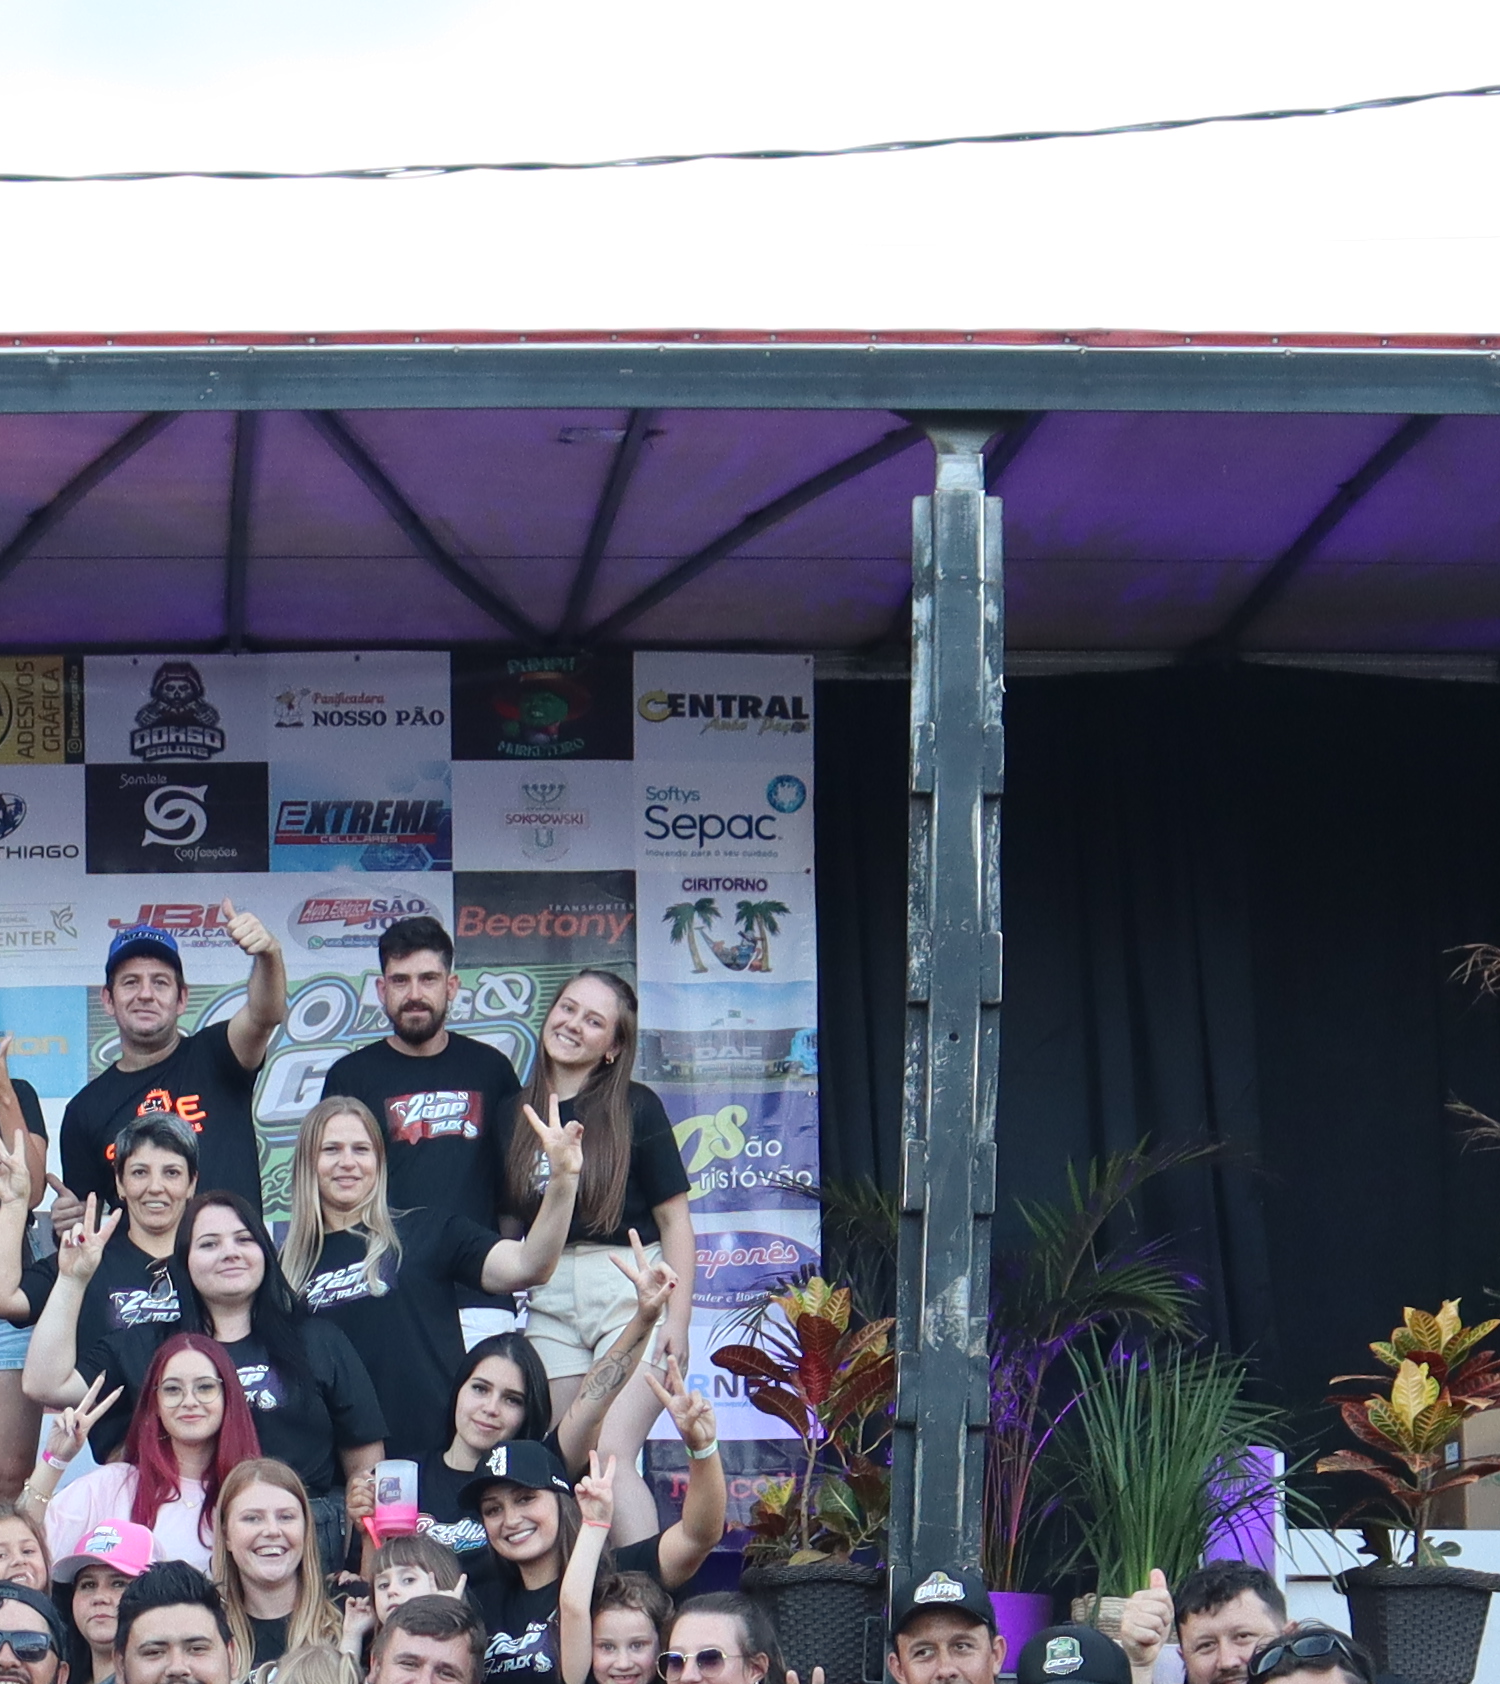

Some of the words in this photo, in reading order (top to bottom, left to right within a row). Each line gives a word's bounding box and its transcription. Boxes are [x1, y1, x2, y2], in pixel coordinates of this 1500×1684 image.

[15, 660, 35, 759] ADESIVOS
[38, 667, 60, 753] GRÁFICA
[312, 692, 385, 708] Panificadora
[638, 690, 810, 722] CENTRAL
[312, 710, 387, 727] NOSSO
[395, 706, 446, 727] PÃO
[645, 786, 701, 805] Softys
[275, 800, 445, 835] EXTREME
[644, 805, 777, 848] Sepac
[319, 835, 399, 844] CELULARES
[682, 878, 768, 892] CIRITORNO
[372, 895, 426, 914] SÃO
[549, 903, 635, 912] TRANSPORTES
[456, 905, 635, 944] Beetony
[695, 1046, 763, 1060] DAF
[695, 1241, 800, 1279] aponês
[692, 1293, 724, 1303] enter
